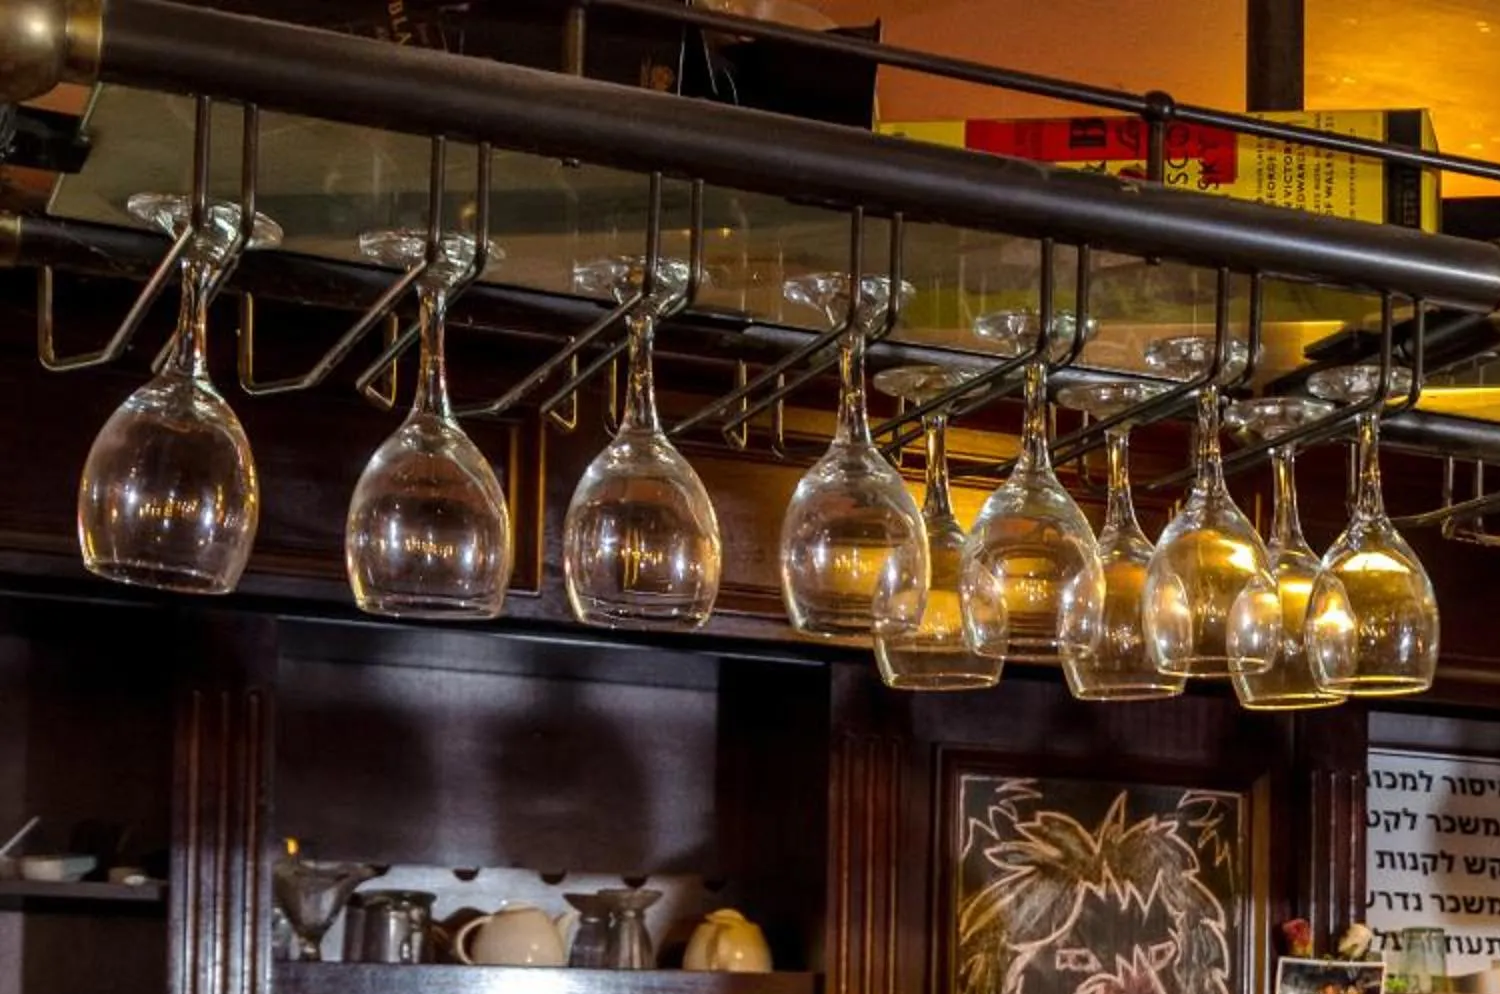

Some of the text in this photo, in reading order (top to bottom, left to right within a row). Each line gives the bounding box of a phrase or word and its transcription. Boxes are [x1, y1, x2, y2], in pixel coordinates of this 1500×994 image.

[1283, 142, 1294, 197] VICTOR
[1426, 812, 1500, 837] משכר
[1375, 849, 1455, 876] לקנות
